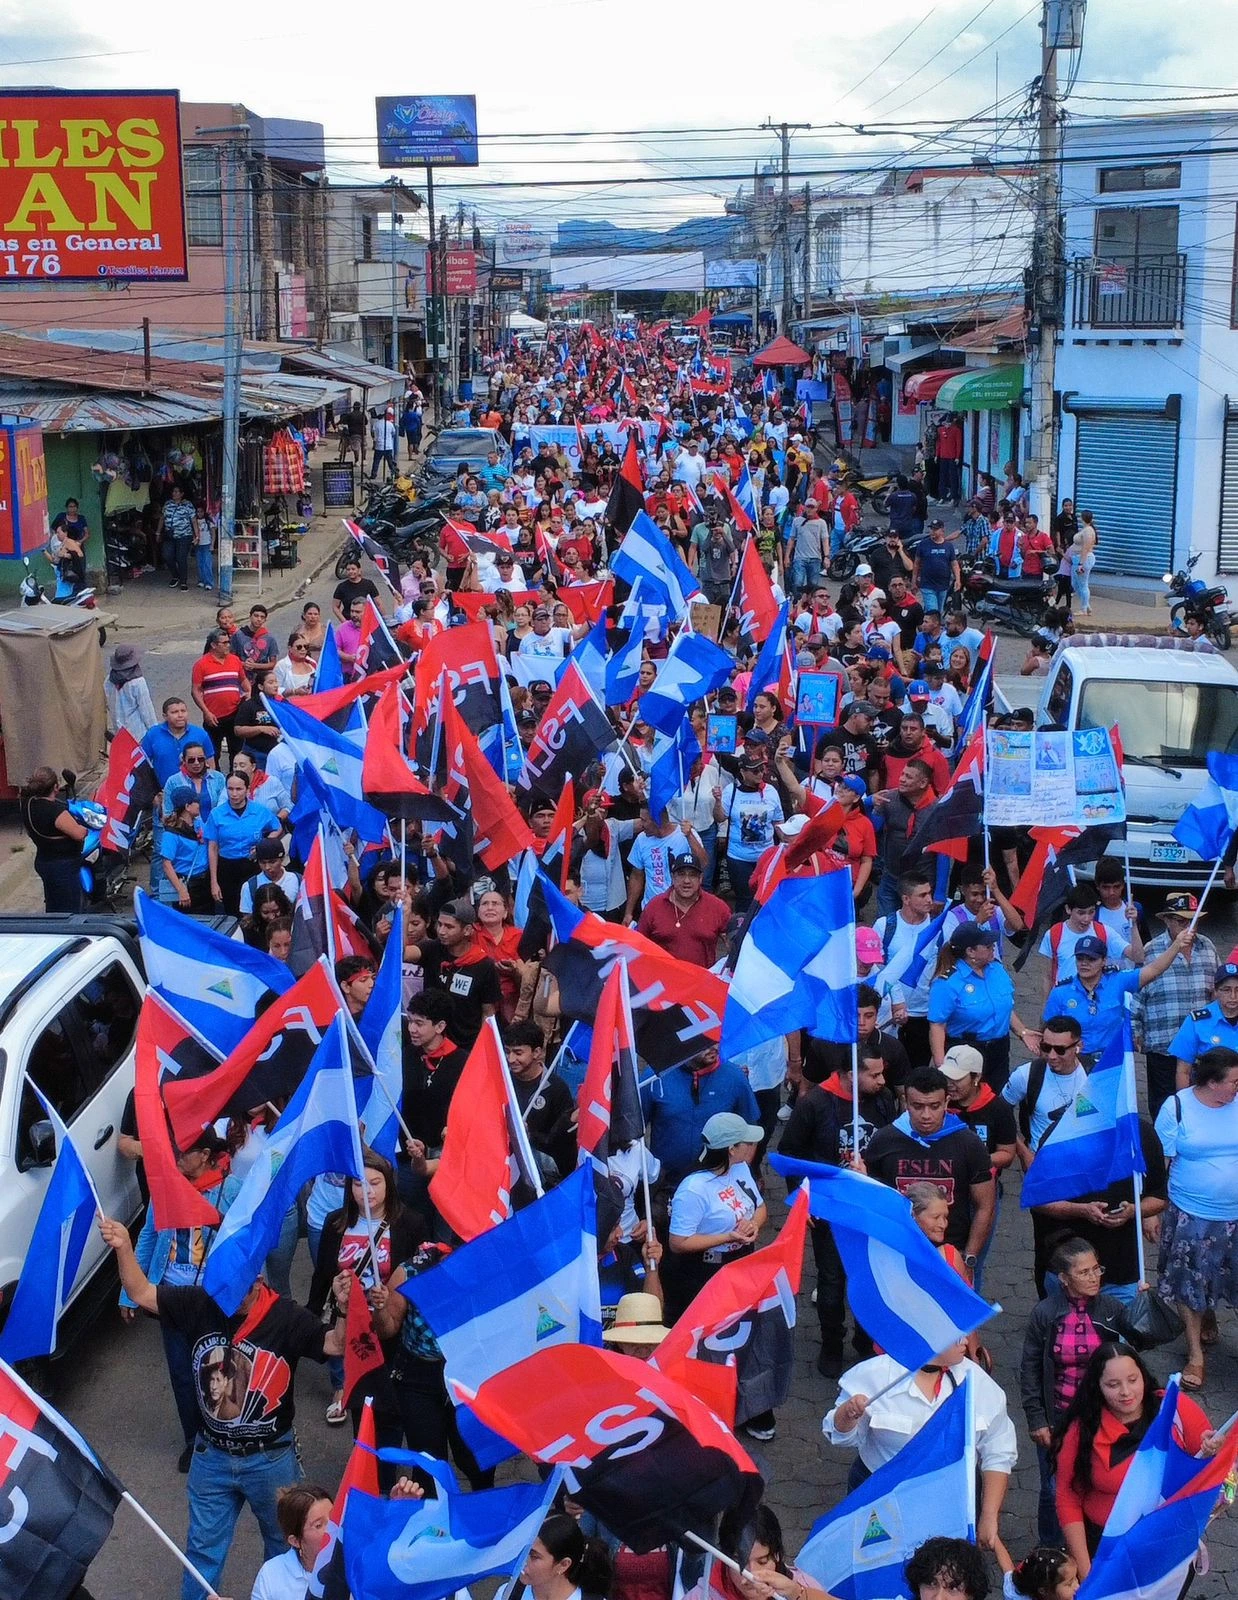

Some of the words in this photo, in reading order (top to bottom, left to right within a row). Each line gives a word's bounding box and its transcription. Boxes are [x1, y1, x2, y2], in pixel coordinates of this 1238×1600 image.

[27, 238, 57, 251] en
[65, 233, 162, 250] General
[4, 254, 61, 275] 176
[453, 978, 470, 991] WE
[897, 1159, 954, 1175] FSLN
